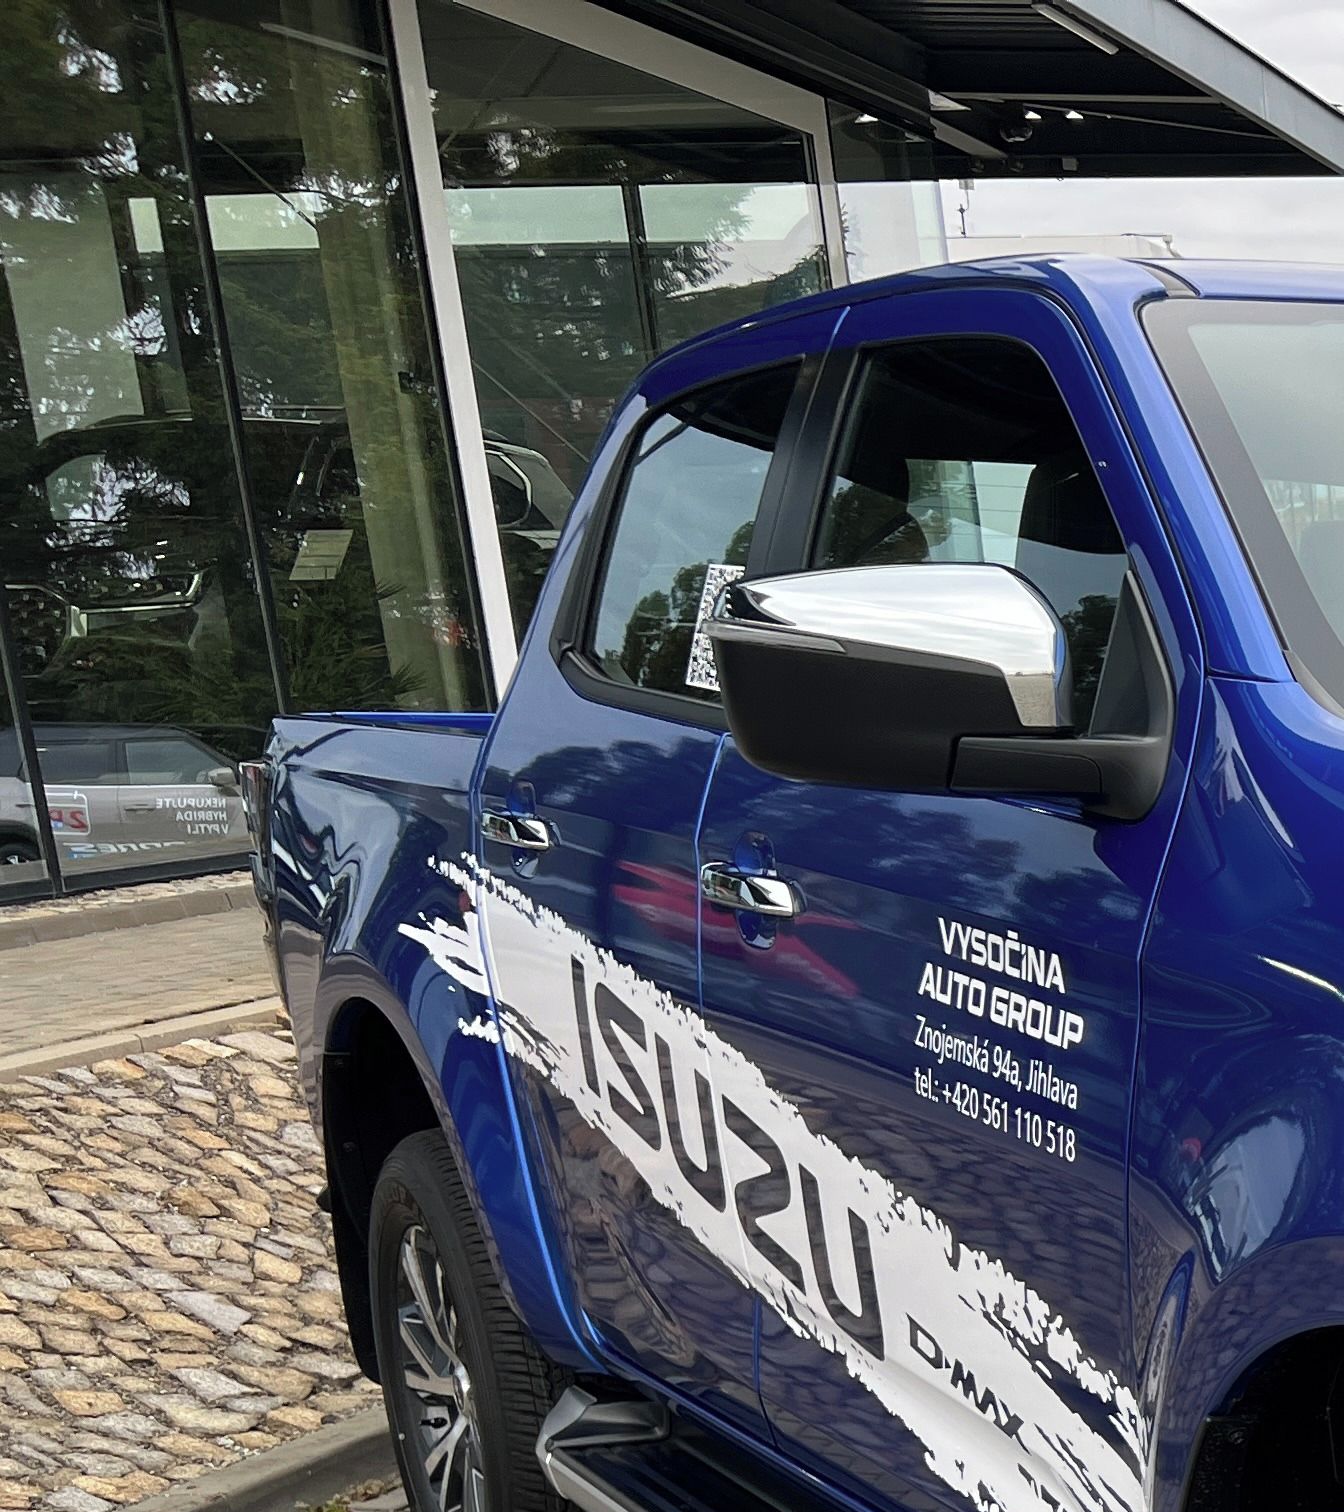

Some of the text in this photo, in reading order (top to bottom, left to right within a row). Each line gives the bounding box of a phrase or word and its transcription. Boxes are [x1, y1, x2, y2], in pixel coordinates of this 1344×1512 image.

[937, 916, 1066, 994] VYSOČINA
[917, 962, 1085, 1049] AUTO GROUP
[914, 1014, 1078, 1110] Znojemská 94a, Jihlava
[571, 953, 886, 1361] ISUZU
[914, 1066, 1077, 1163] tel.: +420 561 110 518
